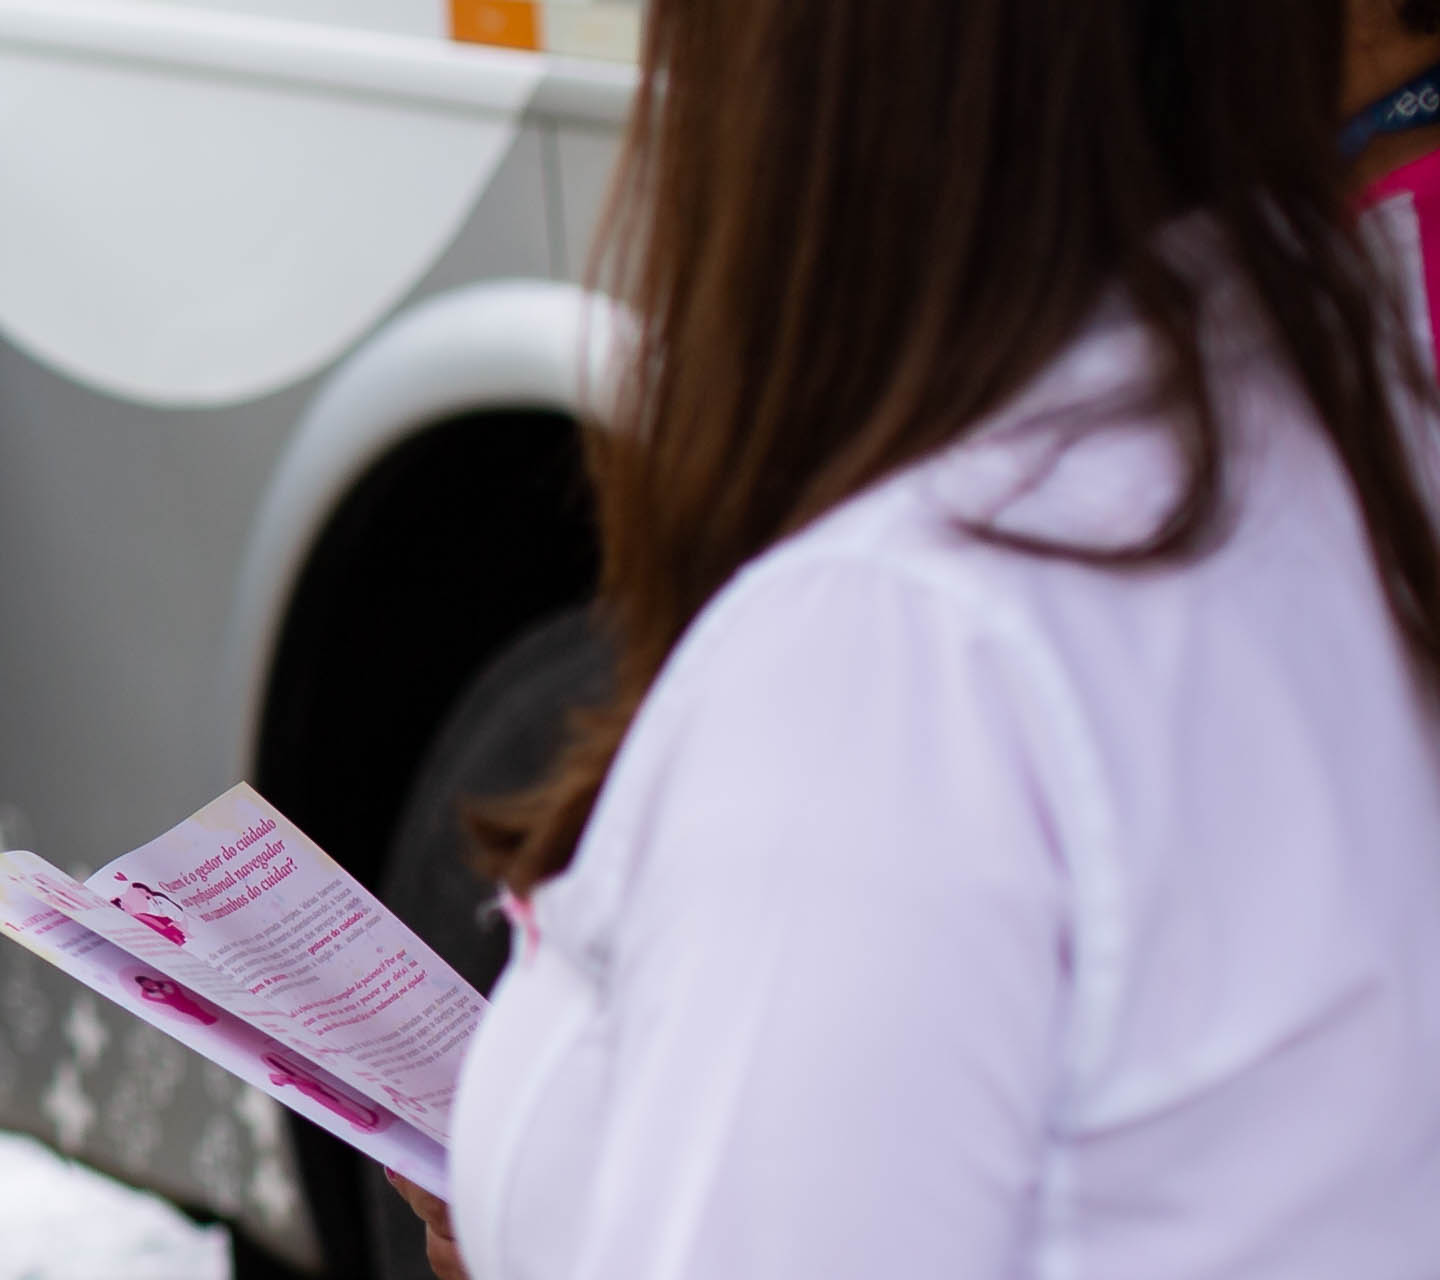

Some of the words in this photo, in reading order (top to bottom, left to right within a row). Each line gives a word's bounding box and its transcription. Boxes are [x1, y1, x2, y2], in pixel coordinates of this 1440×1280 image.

[191, 870, 238, 908] profissional
[234, 839, 286, 881] navegador
[194, 853, 224, 882] gestor
[220, 844, 238, 862] do
[236, 818, 277, 852] cuidado
[246, 884, 262, 901] do
[260, 856, 299, 892] cuidar?
[330, 927, 341, 938] do
[339, 910, 364, 932] cuidado
